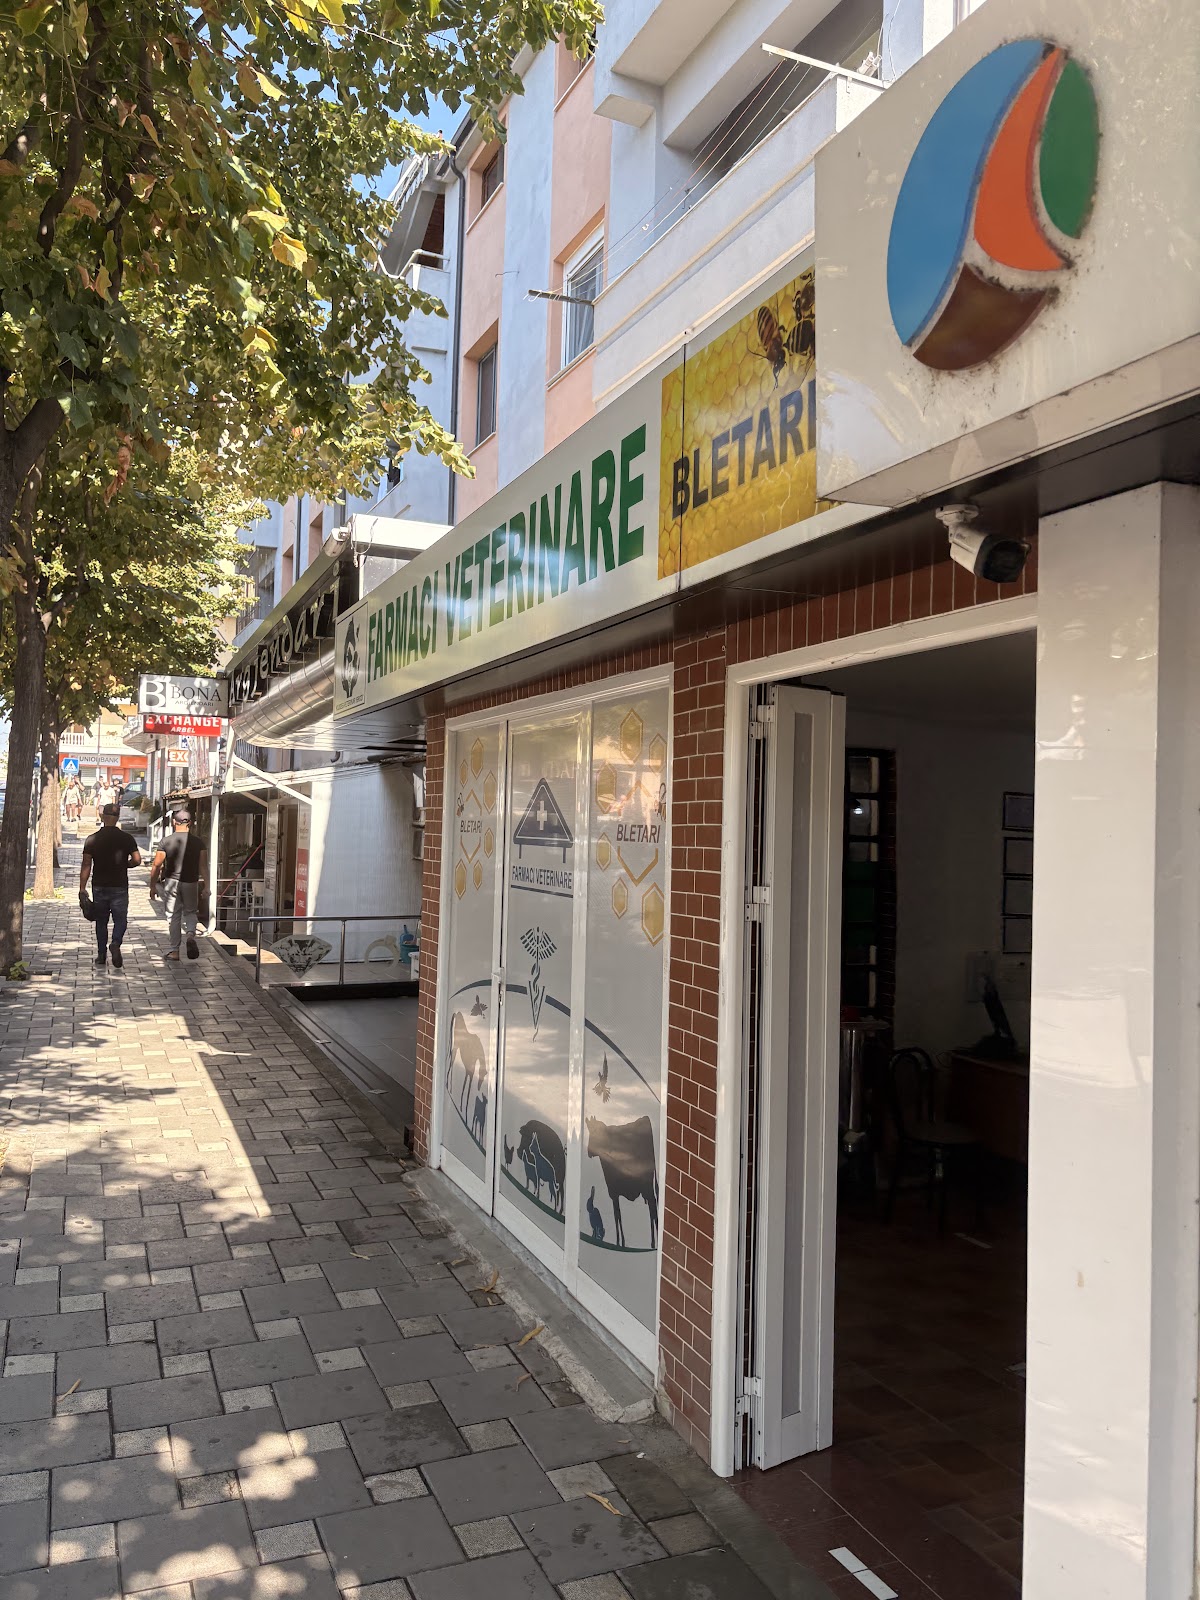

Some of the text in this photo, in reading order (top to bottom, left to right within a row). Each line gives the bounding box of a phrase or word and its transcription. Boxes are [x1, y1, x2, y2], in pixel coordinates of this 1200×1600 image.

[672, 379, 817, 521] BLETARI
[368, 423, 646, 684] FARMACI VETERINARE
[171, 686, 221, 702] BONA
[146, 715, 220, 728] EXCHANGE
[171, 726, 196, 734] ARBEL
[459, 819, 483, 835] BLETARI
[616, 823, 661, 844] BLETARI
[511, 865, 572, 890] FARMACI VETERINARE
